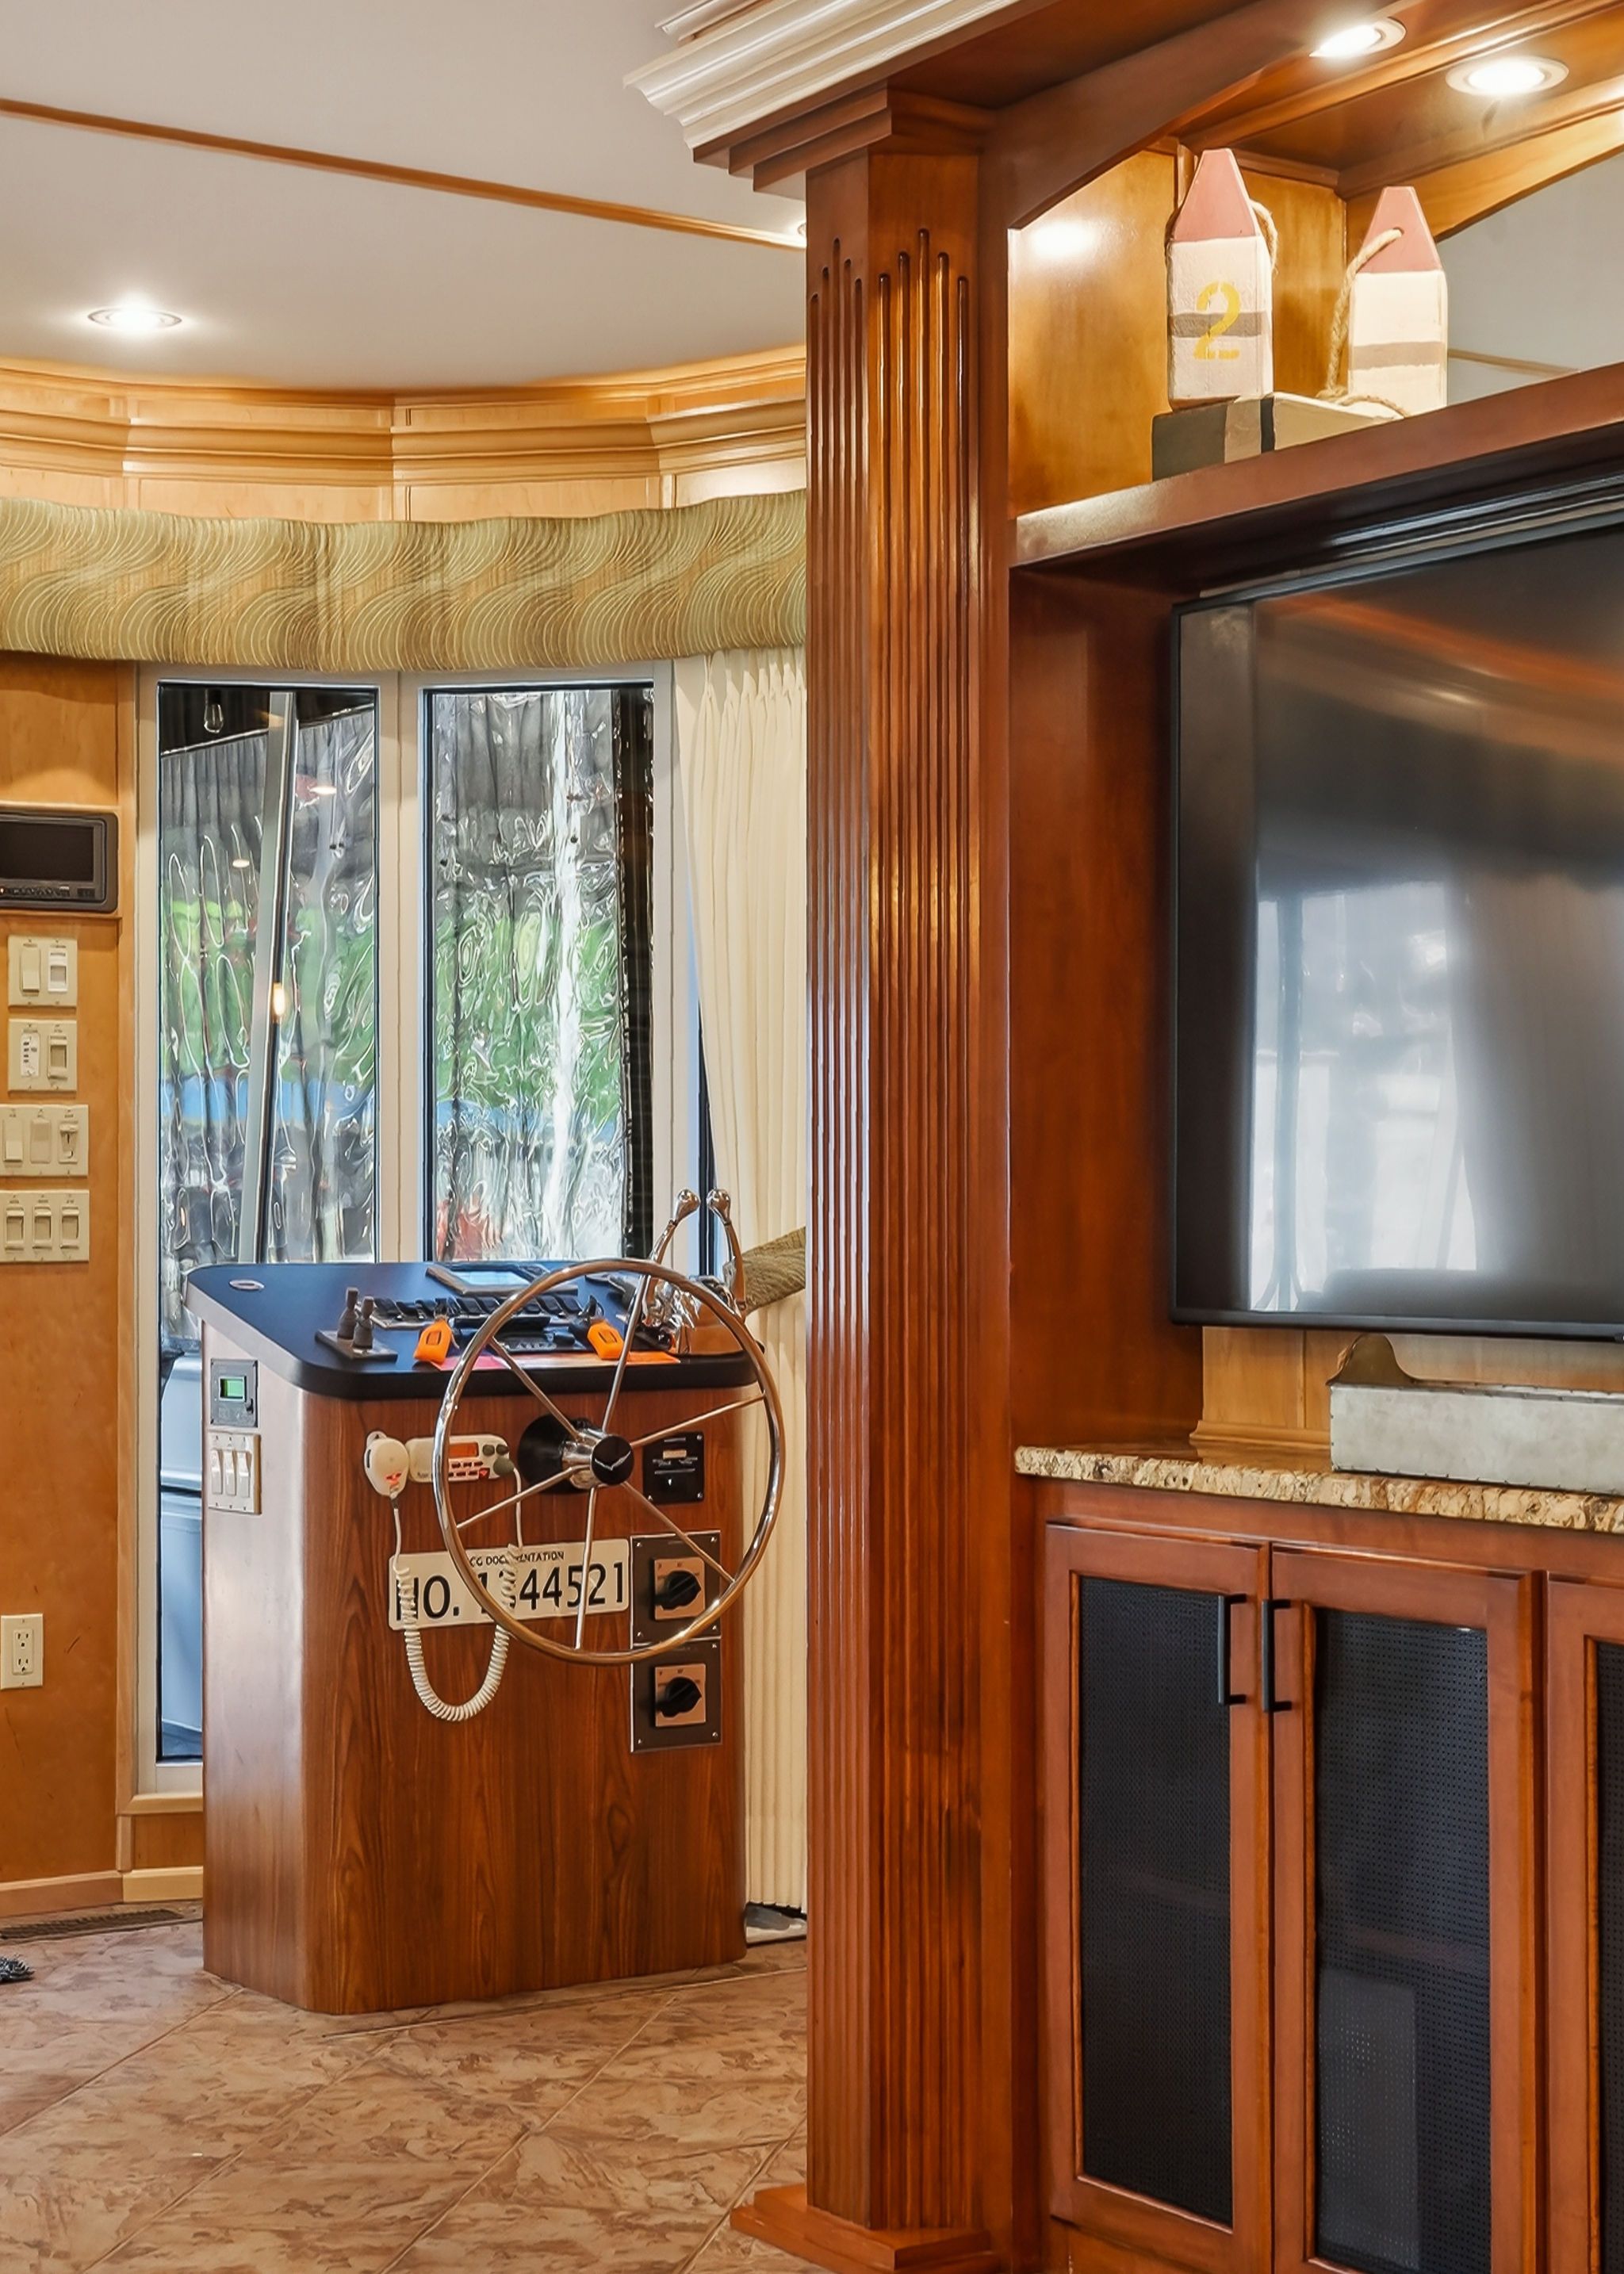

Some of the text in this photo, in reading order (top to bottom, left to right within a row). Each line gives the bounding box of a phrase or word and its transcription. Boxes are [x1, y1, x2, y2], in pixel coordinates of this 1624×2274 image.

[1193, 280, 1242, 361] 2
[485, 1551, 565, 1566] DOCENTATION
[477, 1561, 623, 1614] 144521
